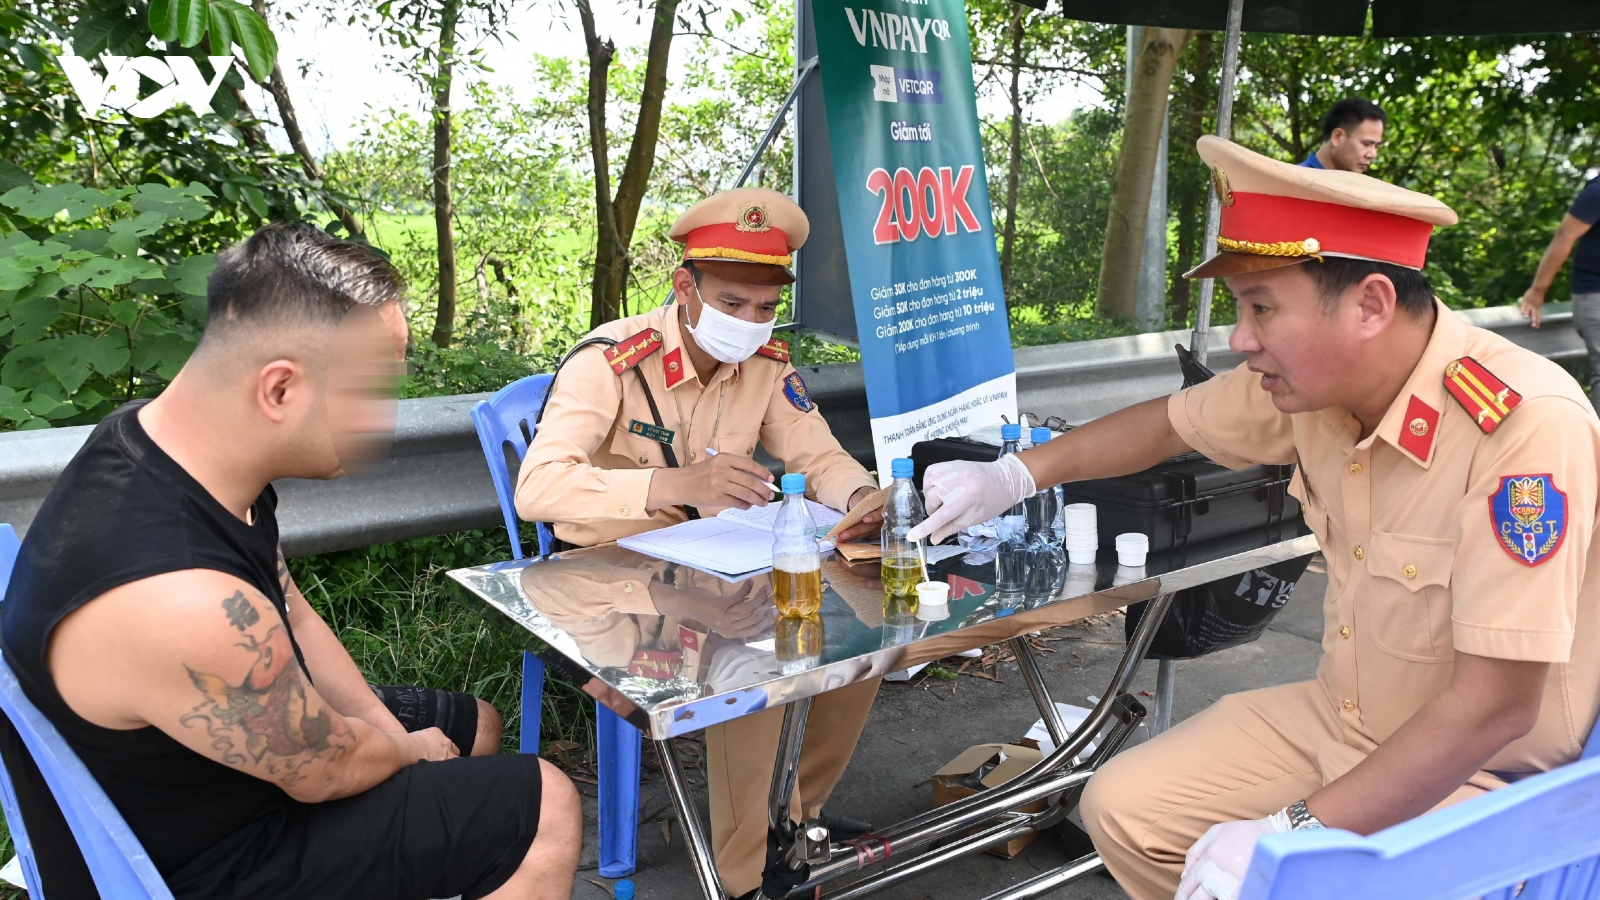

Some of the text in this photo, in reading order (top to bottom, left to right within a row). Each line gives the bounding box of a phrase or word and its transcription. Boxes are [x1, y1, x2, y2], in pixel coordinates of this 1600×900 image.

[899, 78, 934, 95] VETCQR
[890, 121, 932, 141] Giảm tới
[866, 165, 982, 245] 200K
[871, 269, 977, 300] Giảm 30K cho đơn hàng từ 300K
[874, 286, 984, 319] Giảm 50K cho đơn hàng từ 2 triệu
[876, 301, 995, 338] Giảm 200K cho đơn hàng từ 10 triệu
[883, 430, 904, 444] THANH
[904, 423, 915, 437] TOÁN
[989, 391, 1008, 402] VNPAY
[1502, 520, 1556, 534] CSGT
